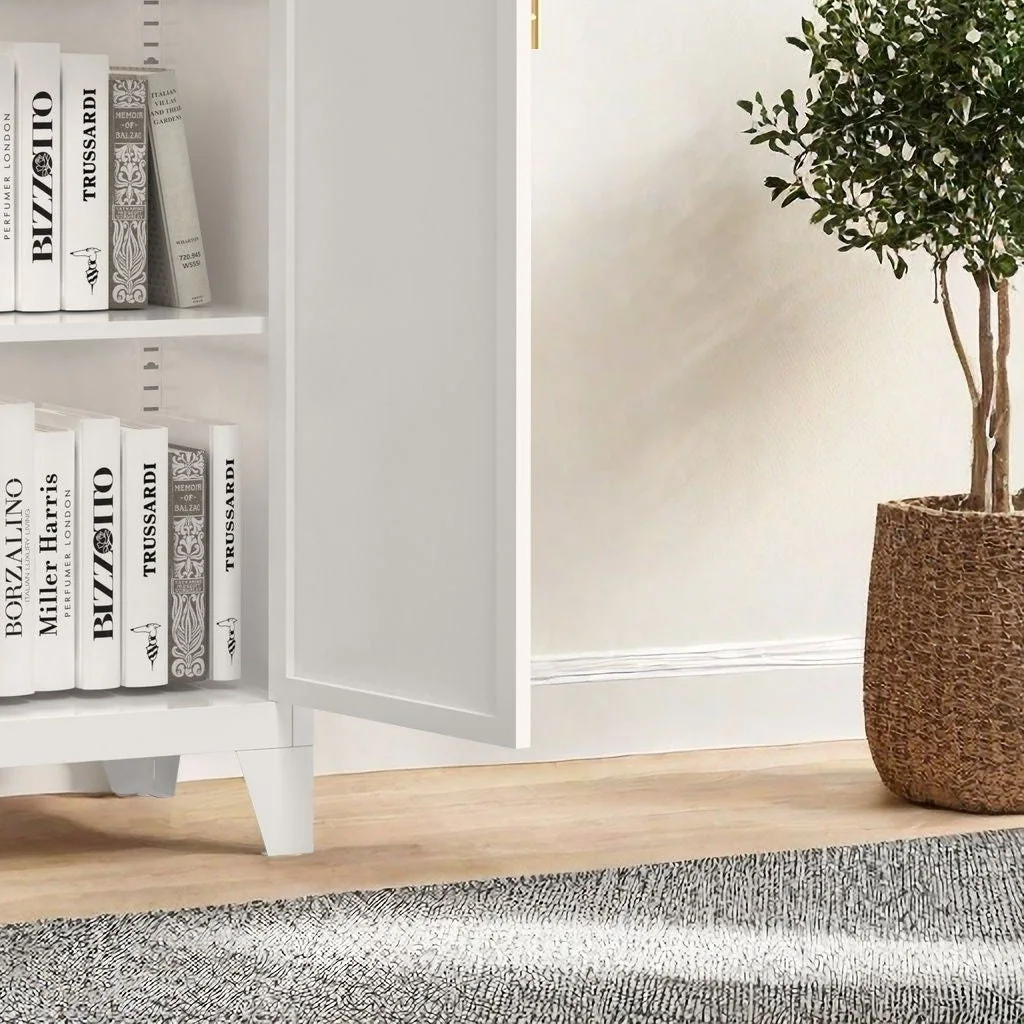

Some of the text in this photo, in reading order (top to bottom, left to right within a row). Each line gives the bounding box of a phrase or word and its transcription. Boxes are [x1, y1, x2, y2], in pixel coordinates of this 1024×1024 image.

[82, 88, 97, 202] TRUSSARDI
[115, 111, 144, 119] MEMOIR
[115, 130, 142, 140] BALZAC
[3, 113, 11, 240] PERFUMER LONDON
[143, 462, 157, 577] TRUSSARDI
[174, 483, 202, 492] MEMOIR
[174, 504, 200, 512] BALZAC
[225, 458, 235, 572] TRUSSARDI
[5, 477, 23, 638] BORZALINO
[39, 473, 59, 637] Miller Harris
